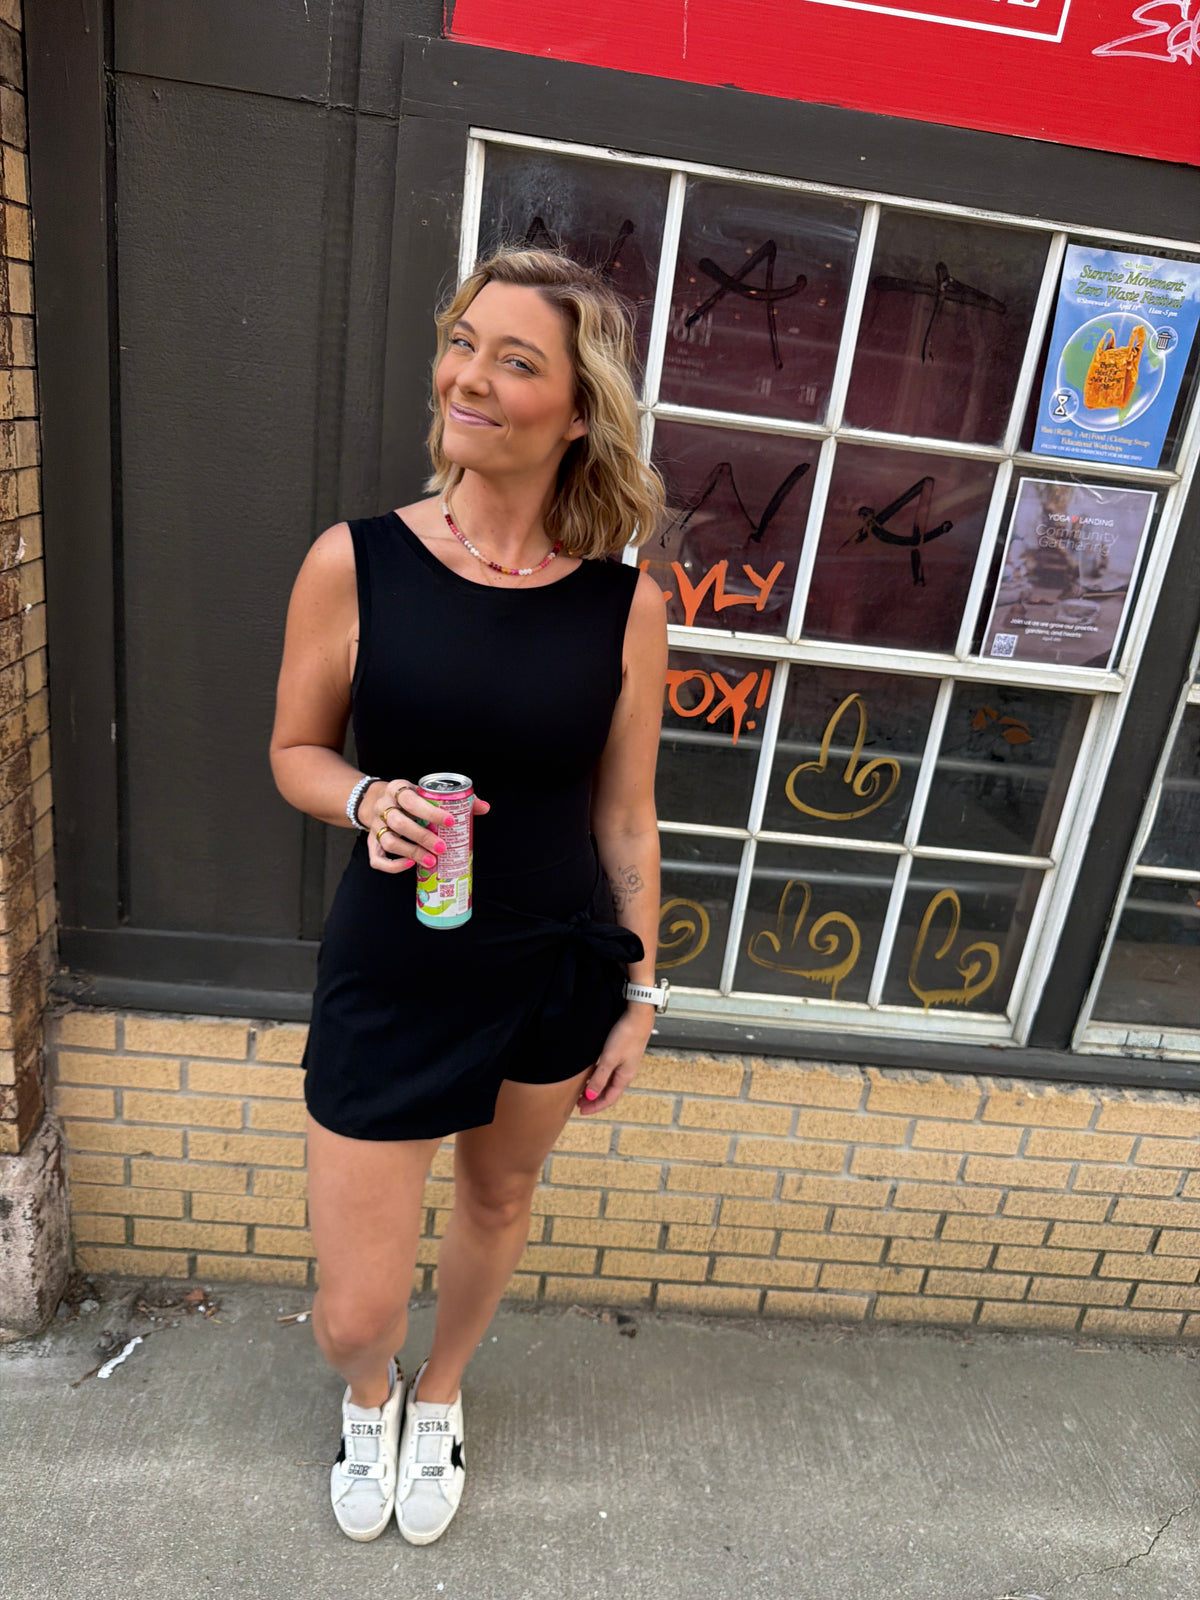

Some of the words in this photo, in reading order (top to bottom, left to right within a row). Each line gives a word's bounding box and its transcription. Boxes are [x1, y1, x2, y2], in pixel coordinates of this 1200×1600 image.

[1080, 264, 1125, 283] Sunrise
[1075, 281, 1104, 297] Zero
[1106, 285, 1140, 302] Waste
[1140, 290, 1186, 309] Festival
[1048, 513, 1071, 522] YOGA
[1079, 516, 1114, 527] LANDING
[1036, 523, 1119, 547] Community
[1038, 535, 1110, 557] Gathering
[350, 1423, 383, 1435] SSTAR
[417, 1421, 450, 1433] SSTAR
